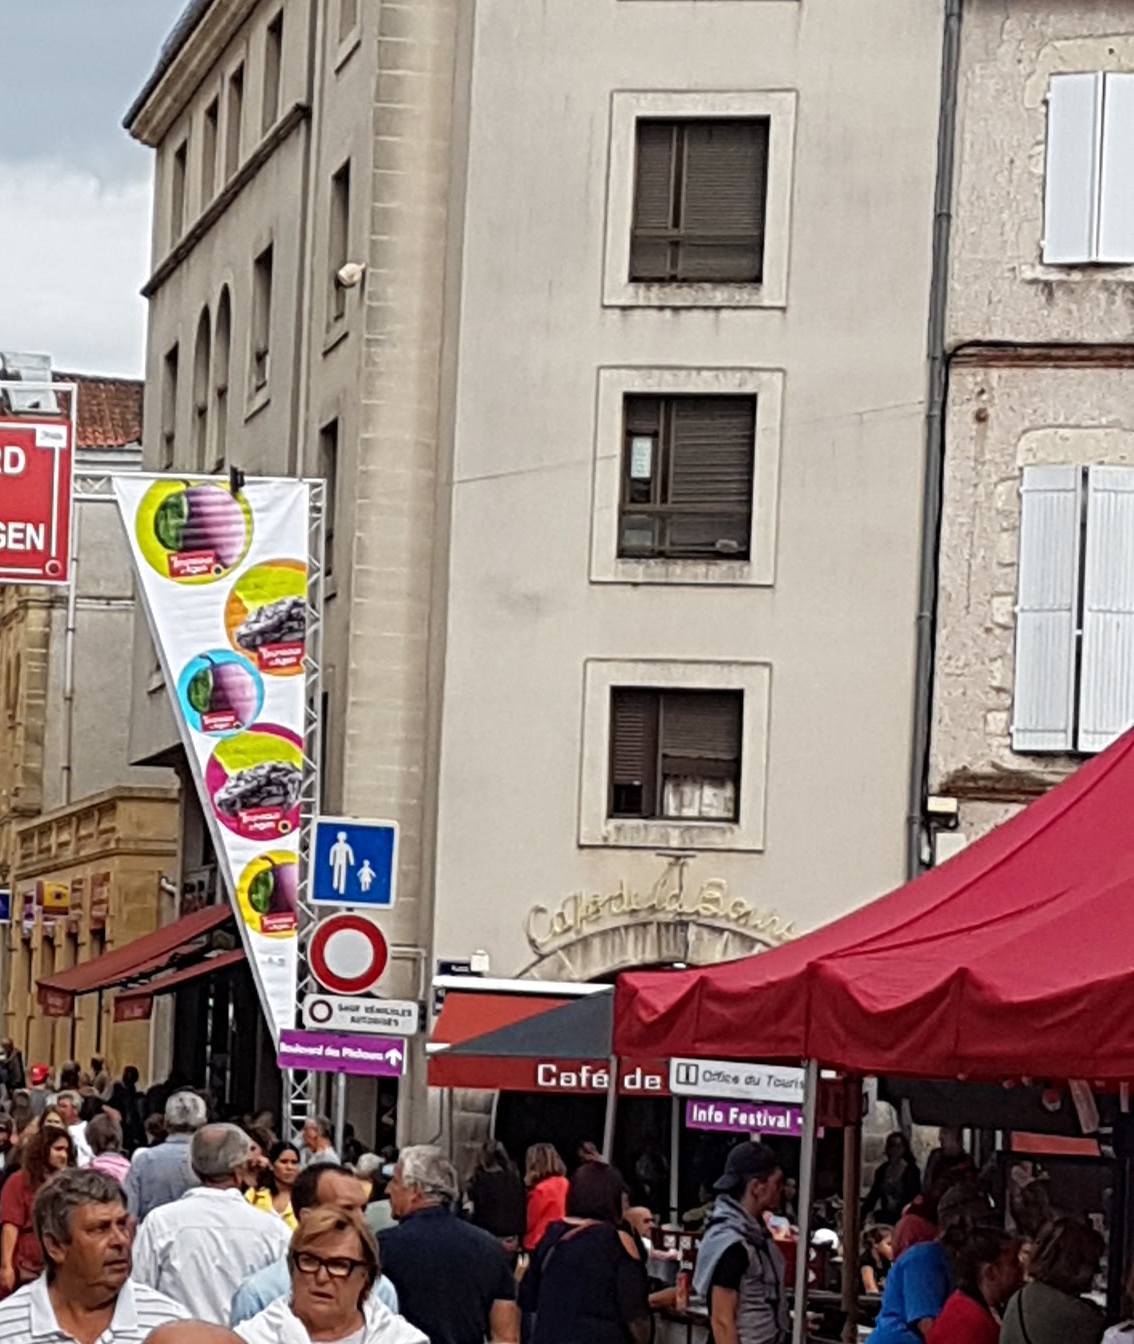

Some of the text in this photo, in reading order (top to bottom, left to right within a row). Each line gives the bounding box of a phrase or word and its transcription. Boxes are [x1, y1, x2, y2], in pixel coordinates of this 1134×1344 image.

[537, 1063, 662, 1090] Café de
[744, 1074, 761, 1086] du
[692, 1105, 791, 1128] Info Festival
